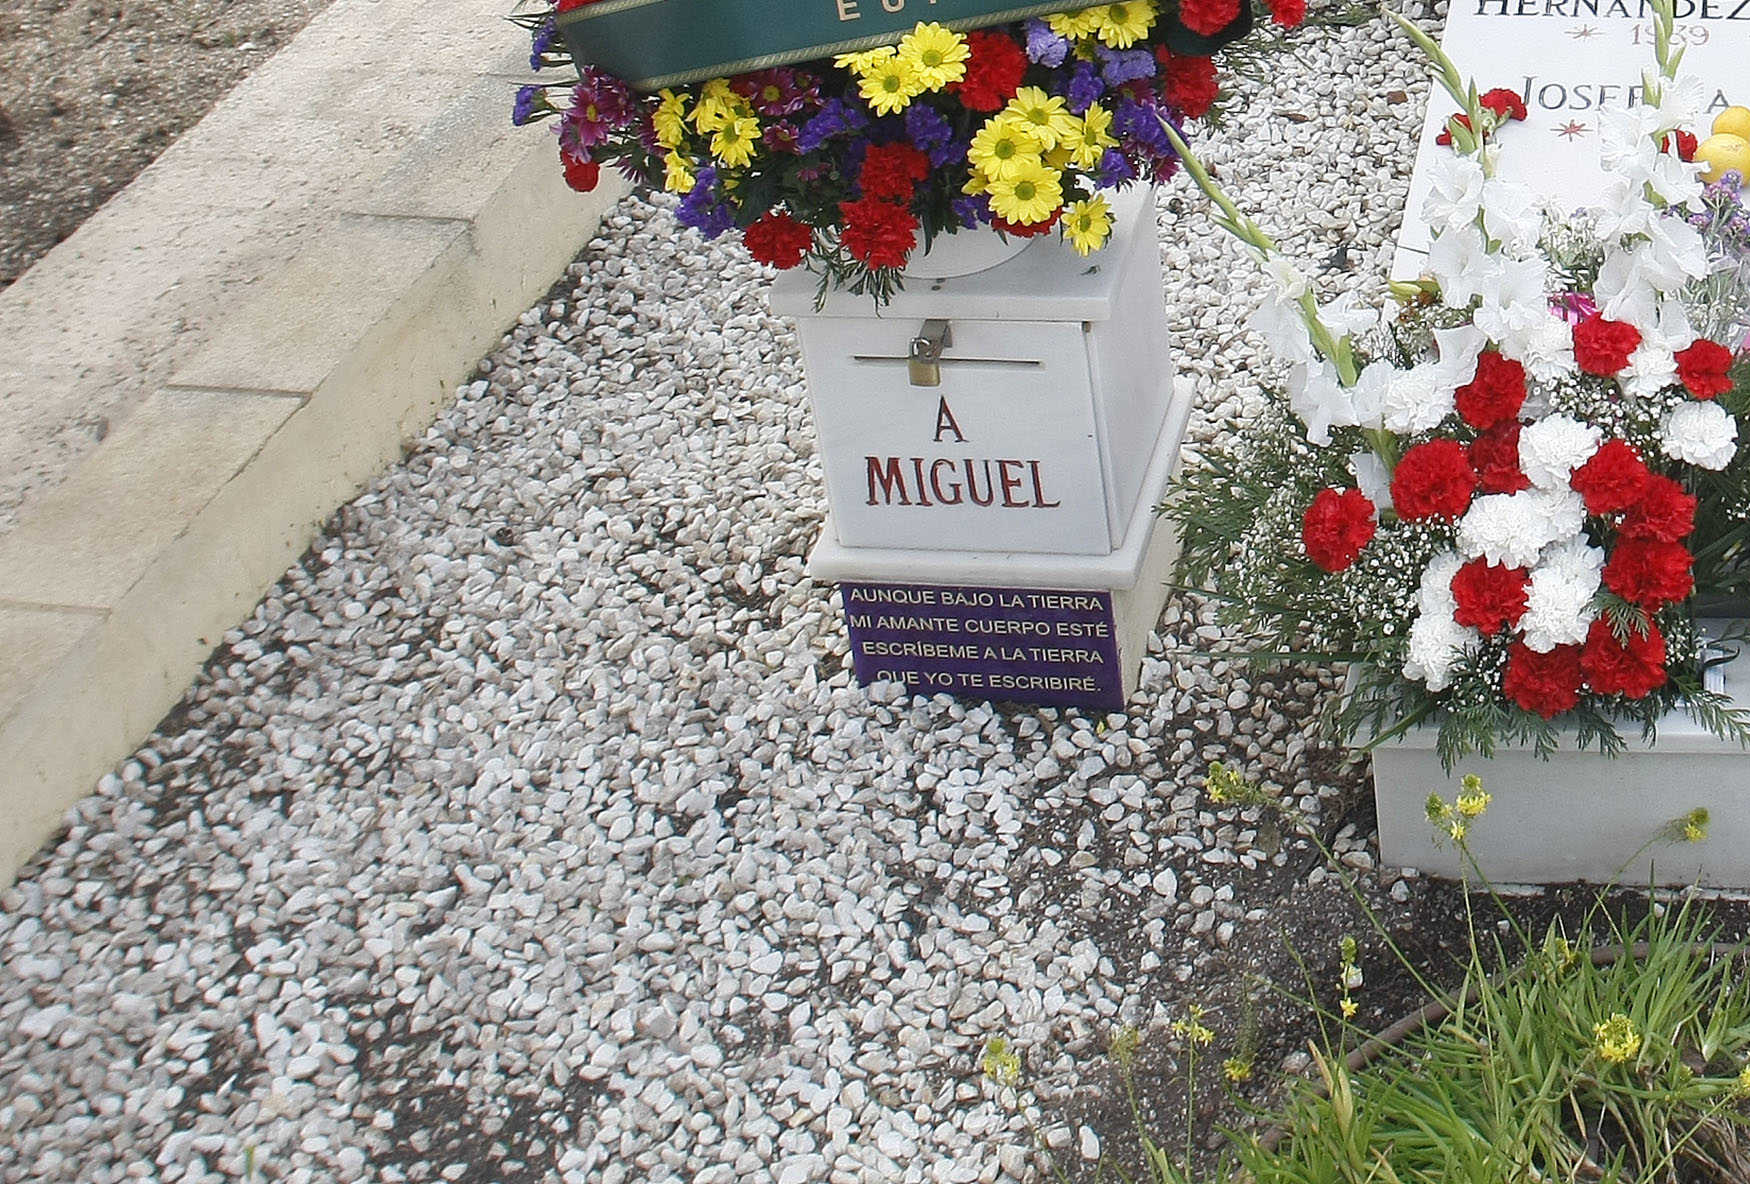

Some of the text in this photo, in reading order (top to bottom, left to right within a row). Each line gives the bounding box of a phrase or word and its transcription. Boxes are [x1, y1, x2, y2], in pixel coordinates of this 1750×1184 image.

[1522, 76, 1730, 114] JOSEFA
[932, 395, 969, 443] A
[865, 456, 1061, 508] MIGUEL
[850, 588, 1104, 611] AUNQUE BAJO LA TIERRA
[850, 615, 1109, 637] MI AMANTE CUERPO ESTÉ
[862, 641, 1104, 664] ESCRÍBEME A LA TIERRA
[924, 672, 953, 686] YO
[957, 673, 984, 687] TE
[989, 675, 1101, 692] ESCRIBIRÉ.
